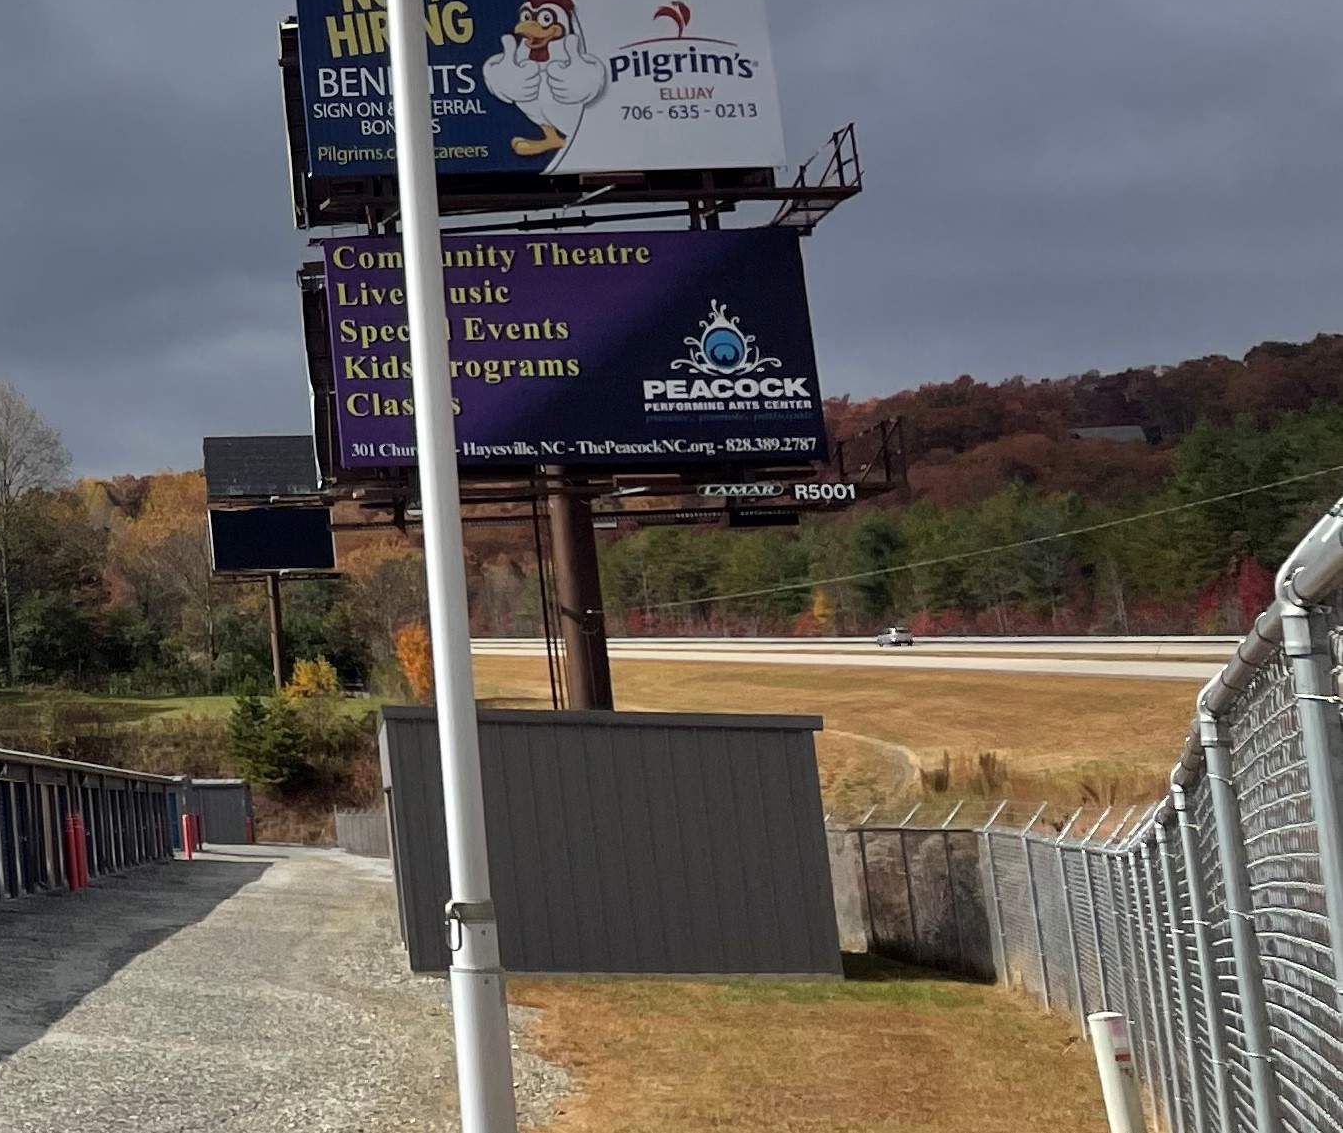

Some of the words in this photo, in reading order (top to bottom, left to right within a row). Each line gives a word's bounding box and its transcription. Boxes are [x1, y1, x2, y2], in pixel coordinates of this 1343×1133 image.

[326, 0, 474, 58] HIRNG
[609, 46, 753, 83] Pilgrim's
[318, 64, 476, 98] BENITS
[313, 102, 353, 118] SIGN
[356, 101, 383, 117] ON
[432, 99, 487, 116] ERRAL
[621, 105, 653, 120] 706
[668, 104, 700, 119] 635
[715, 102, 758, 118] 0213
[360, 118, 441, 136] BONS
[318, 144, 489, 165] Pilgrims.ccareers
[332, 244, 515, 273] Comunity
[526, 242, 651, 266] Theatre
[337, 282, 404, 306] Live
[449, 279, 510, 304] usic
[339, 318, 451, 349] Specl
[463, 316, 569, 342] Events
[343, 355, 412, 380] Kids
[450, 357, 580, 384] rograms
[643, 377, 811, 400] PEACOCK
[345, 392, 461, 417] Class
[644, 402, 725, 412] PERFORMING
[729, 401, 760, 410] ARTS
[764, 400, 812, 410] CENTER
[351, 443, 376, 457] 301
[379, 443, 418, 457] Chur
[463, 441, 538, 459] Hayesville,
[540, 441, 565, 455] NC
[576, 440, 716, 456] ThePeacockNC.org
[726, 437, 816, 452] 828.389.2787
[704, 484, 776, 496] LAMAR
[794, 483, 856, 500] R5001
